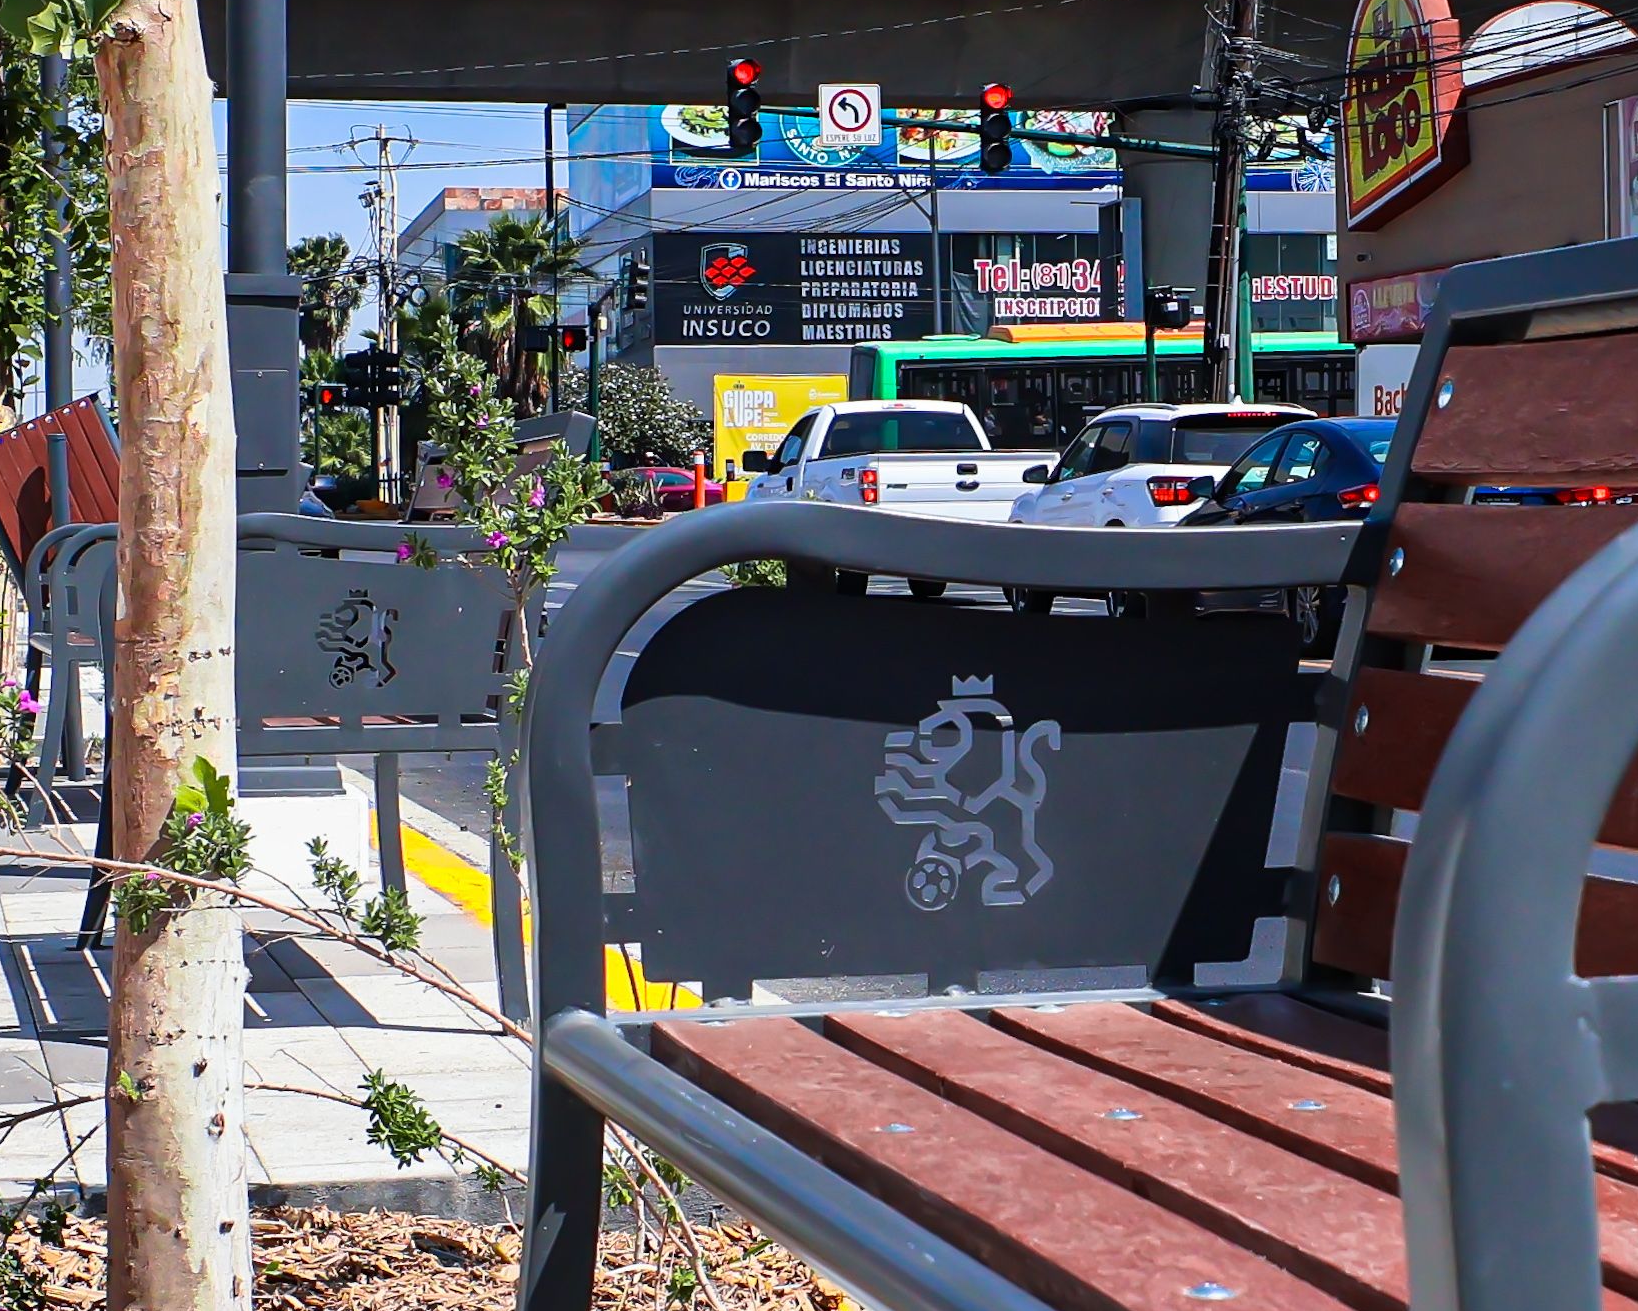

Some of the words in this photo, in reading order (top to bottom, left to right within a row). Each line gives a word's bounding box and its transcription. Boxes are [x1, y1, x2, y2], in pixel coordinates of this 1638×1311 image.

[786, 128, 828, 163] SANTO
[825, 133, 849, 142] ESPERE
[853, 133, 862, 142] SU
[864, 133, 877, 142] LUZ
[744, 172, 820, 187] Mariscos
[845, 173, 894, 187] Santo
[800, 239, 900, 255] INGENIERIAS
[800, 260, 924, 276] LICENCIATURAS
[801, 281, 919, 297] PREPARATORIA
[683, 304, 773, 315] UNIVERSIDAD
[802, 303, 904, 319] DIPLOMADOS
[682, 319, 771, 337] INSUCO
[802, 324, 892, 340] MAESTRIAS
[723, 390, 775, 408] GUAPA
[724, 408, 762, 427] LUPE
